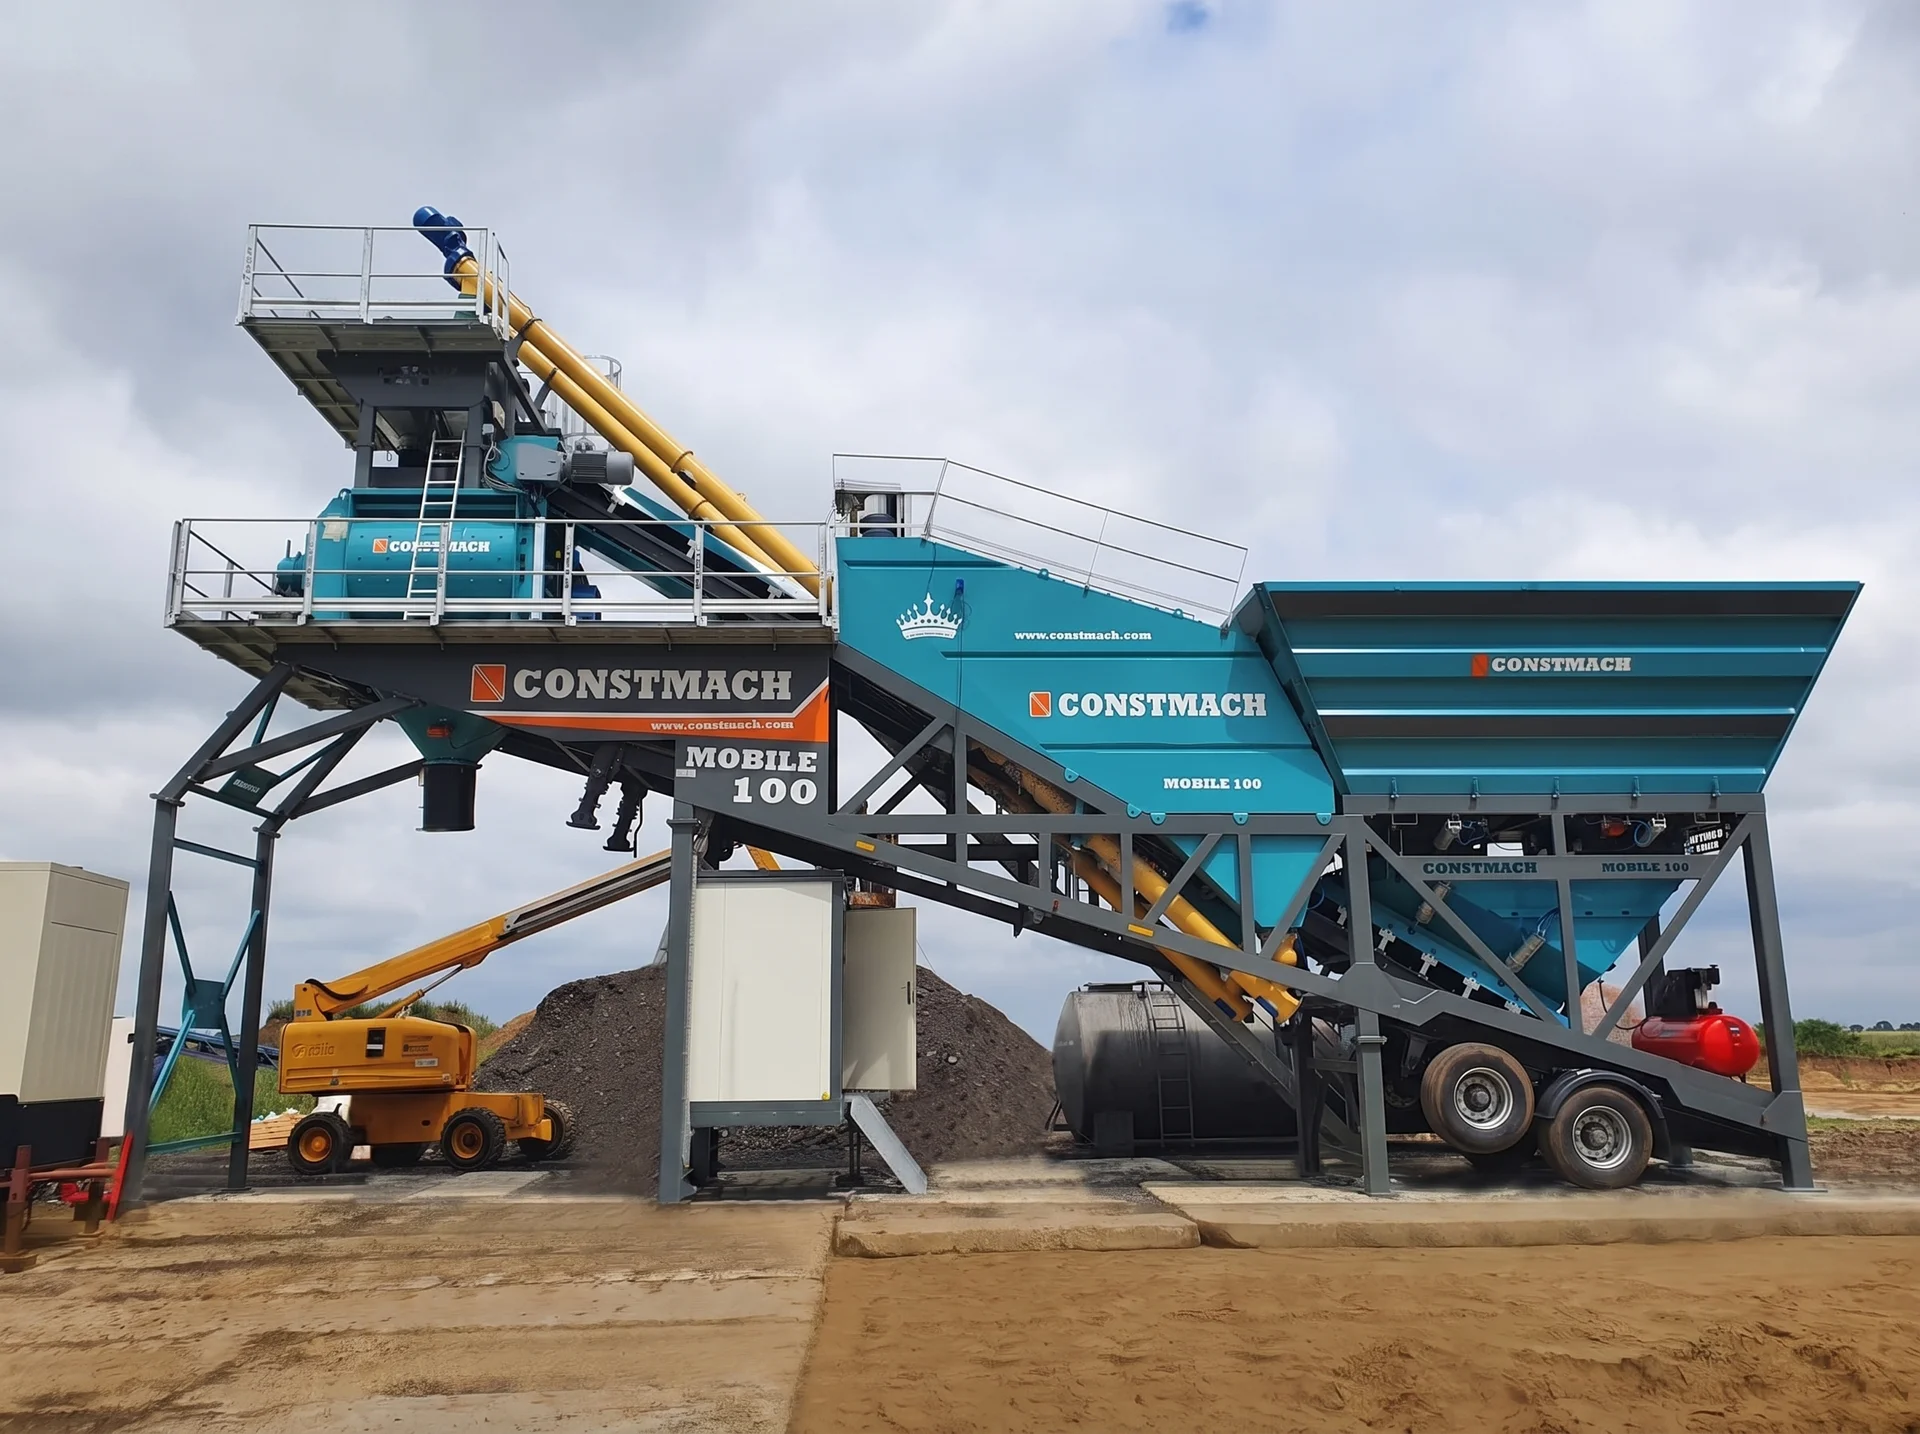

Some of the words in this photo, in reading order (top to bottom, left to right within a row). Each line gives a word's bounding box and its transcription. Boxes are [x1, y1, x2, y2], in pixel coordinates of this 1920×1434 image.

[1014, 630, 1152, 640] www.constmach.com
[1491, 657, 1631, 672] CONSTMACH
[513, 668, 792, 700] CONSTMACH
[1058, 692, 1267, 717] CONSTMACH
[685, 746, 817, 773] MOBILE
[732, 777, 817, 805] 100
[1163, 778, 1230, 790] MOBILE
[1233, 778, 1262, 790] 100
[1422, 861, 1538, 874] CONSTMACH
[1601, 862, 1661, 872] MOBILE
[1664, 862, 1690, 872] 100
